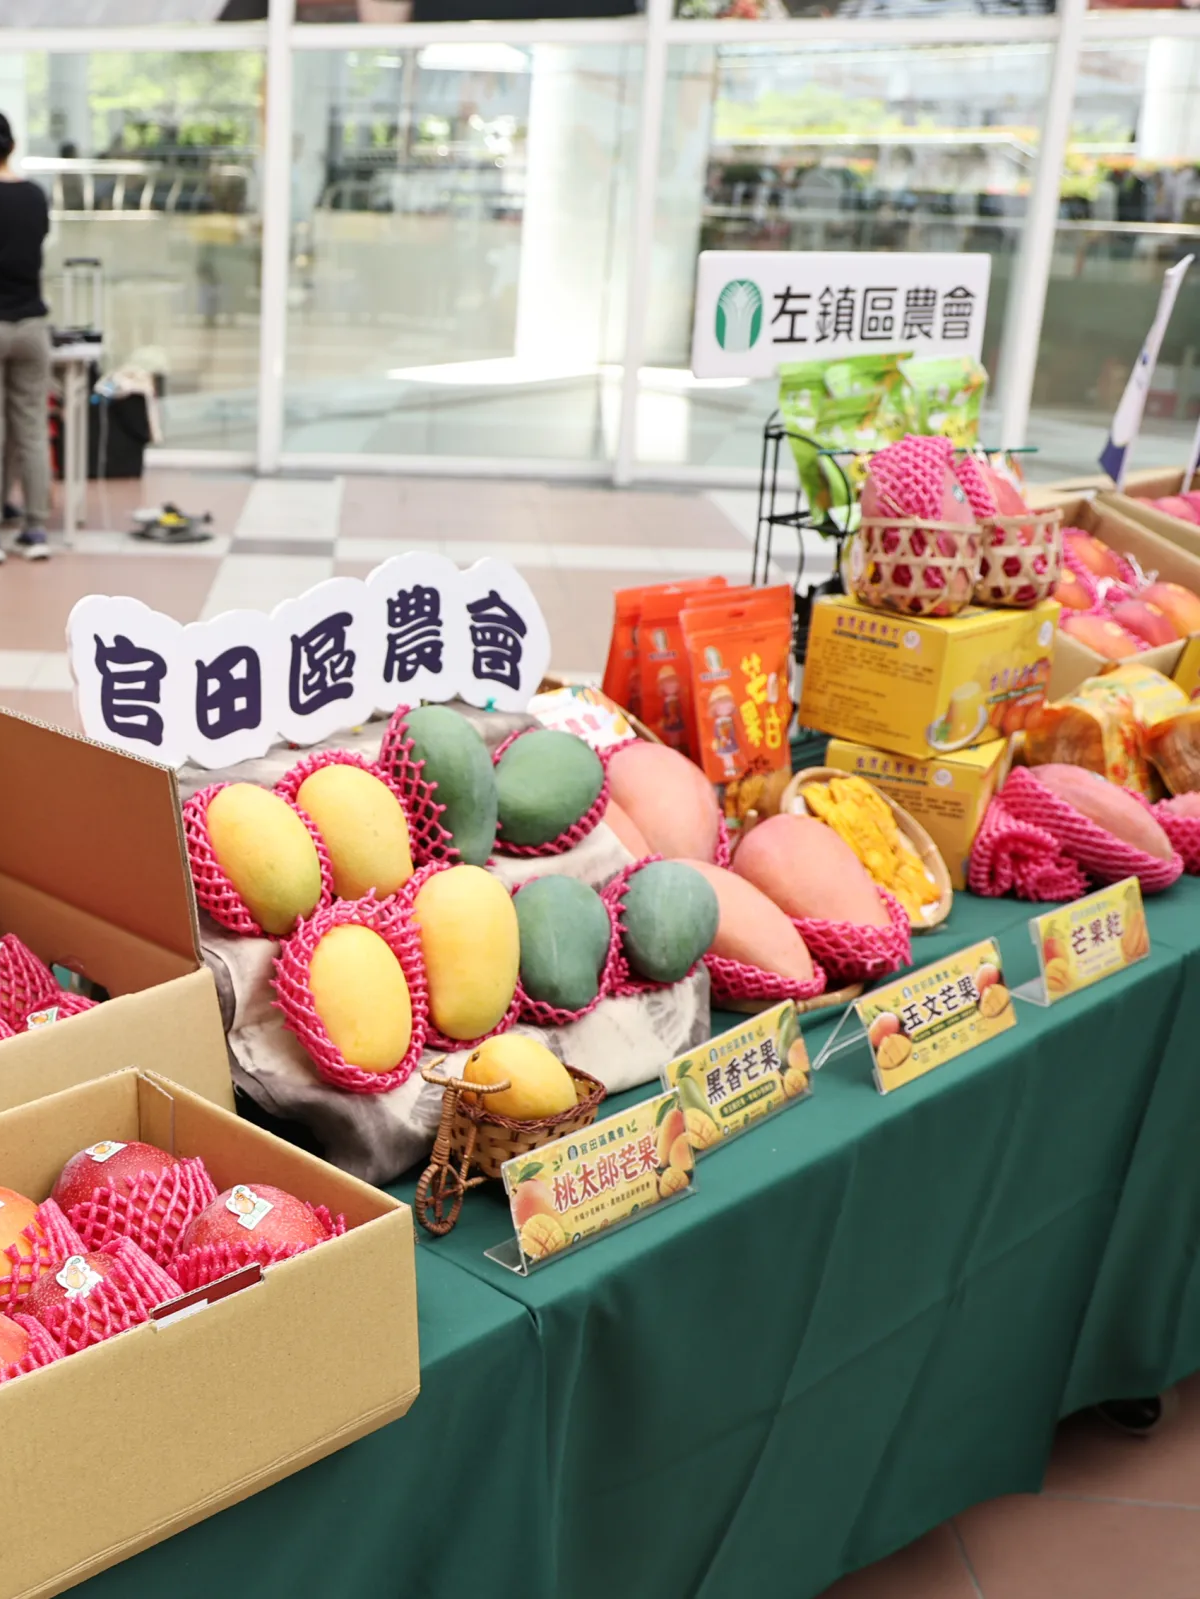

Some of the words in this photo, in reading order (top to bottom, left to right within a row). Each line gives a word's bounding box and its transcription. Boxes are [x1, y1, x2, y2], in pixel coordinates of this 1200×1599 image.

[771, 285, 977, 343] 左鎮區農會
[93, 584, 528, 746] 官田區農會
[902, 976, 978, 1031] 玉文芒果
[706, 1038, 779, 1105] 黑香芒果
[552, 1134, 660, 1213] 桃太郎芒果
